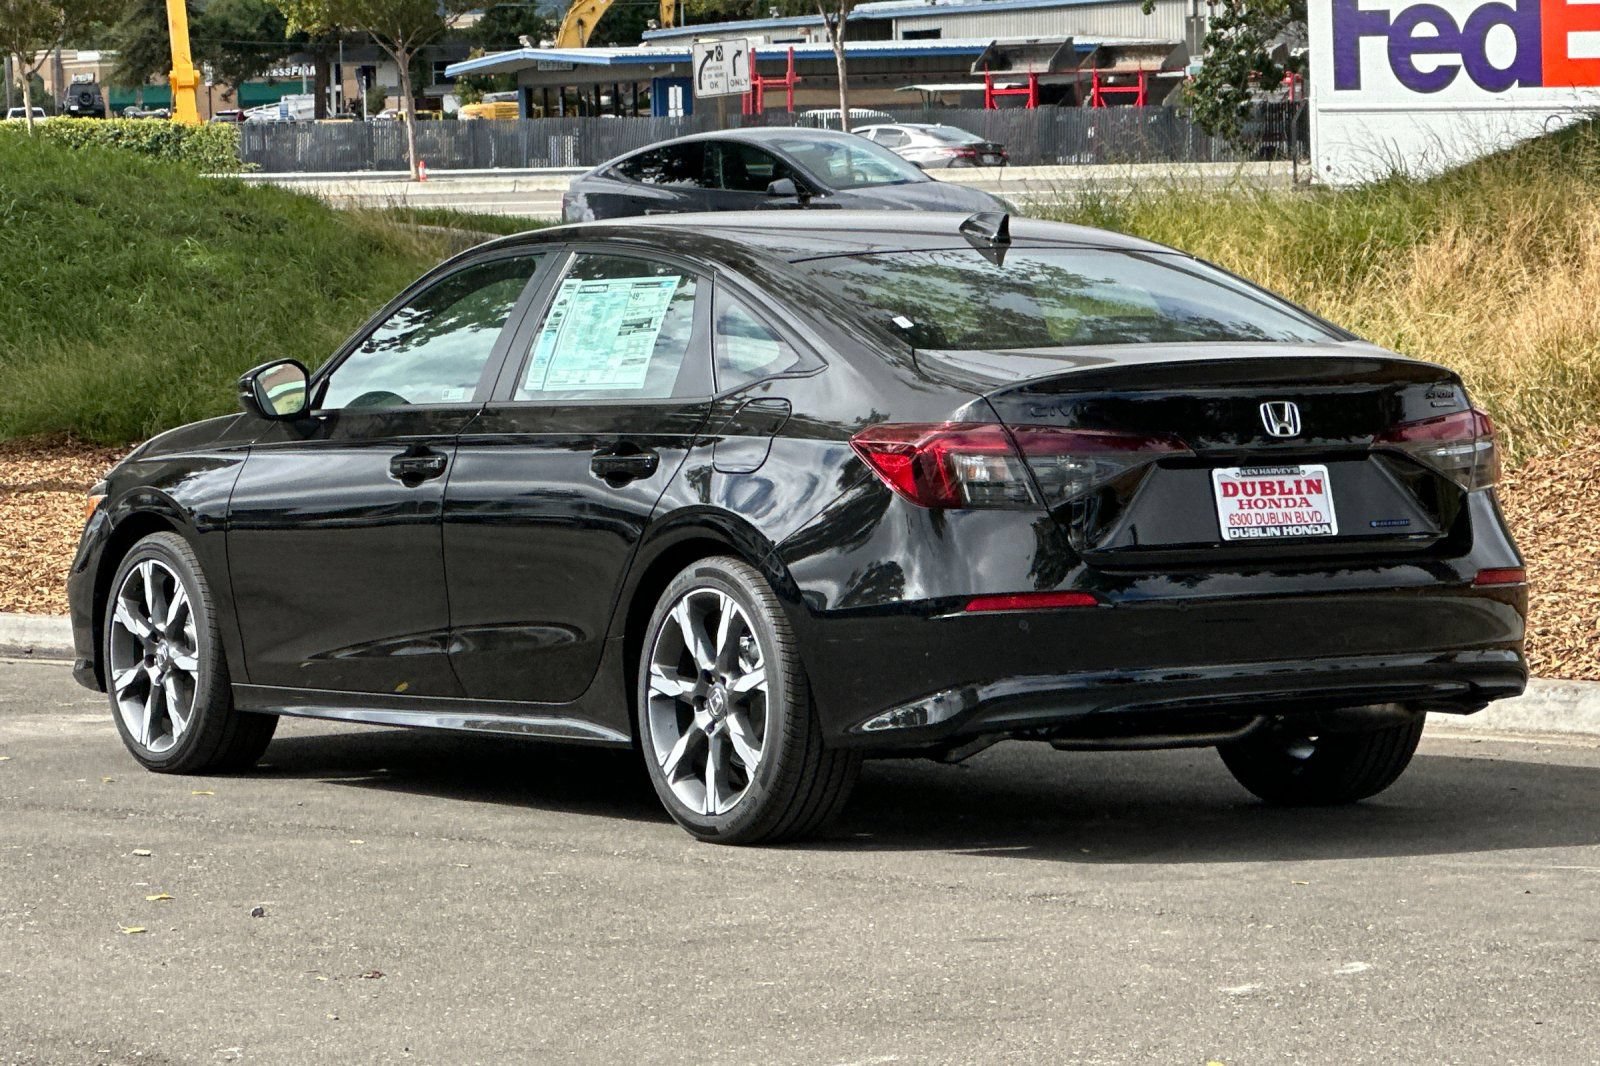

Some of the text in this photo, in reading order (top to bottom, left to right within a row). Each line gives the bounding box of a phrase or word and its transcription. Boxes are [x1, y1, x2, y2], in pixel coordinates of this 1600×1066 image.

[709, 81, 719, 89] OK
[730, 78, 748, 87] ONLY
[1241, 467, 1300, 476] KEN HARVEY'S
[1220, 479, 1323, 497] DUBLIN
[1236, 497, 1313, 510] HONDA
[1229, 510, 1326, 526] 6300 DUBLIN BLVD.
[1229, 524, 1331, 538] DUBLIN HONDA
